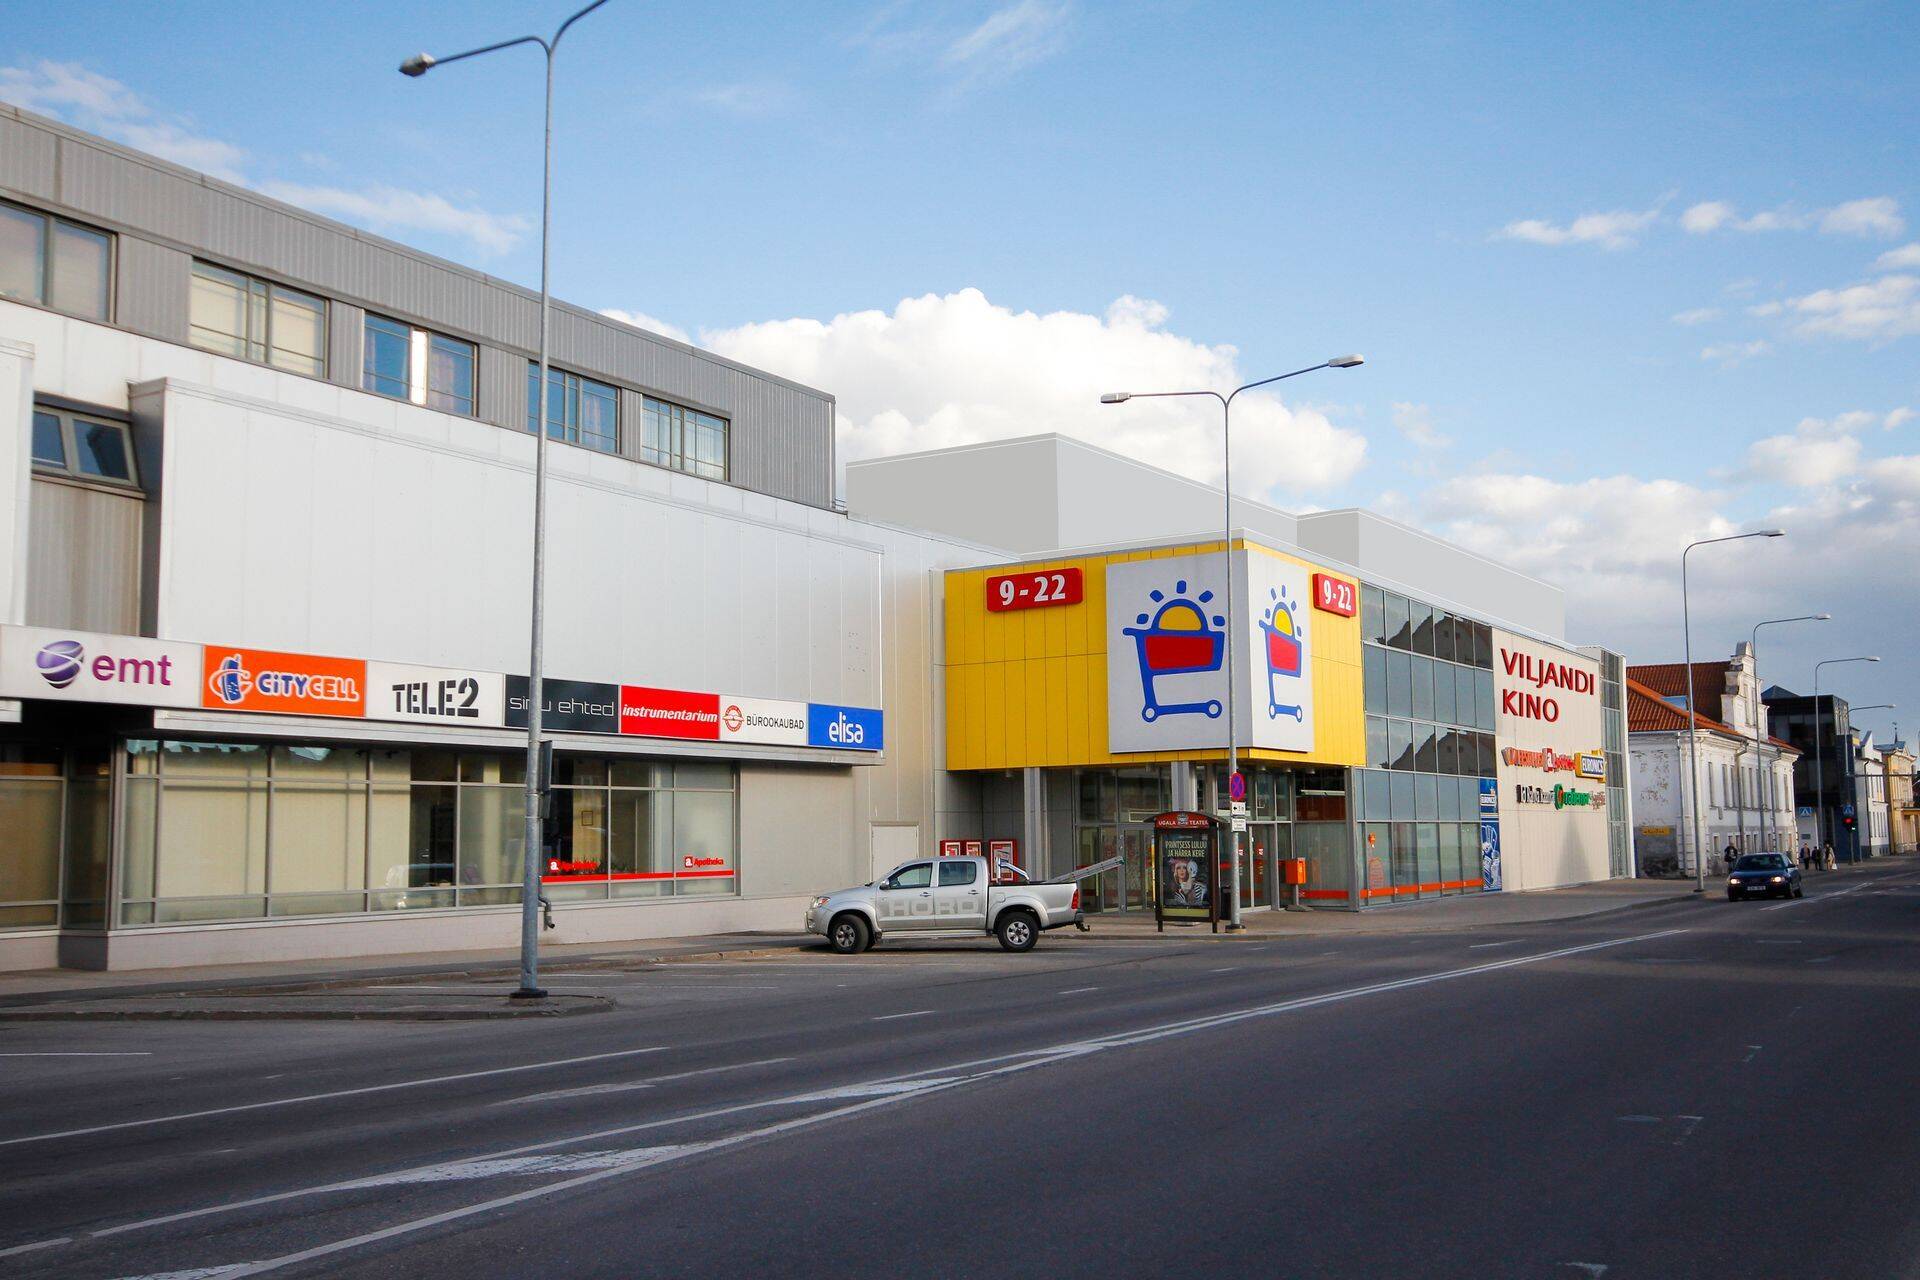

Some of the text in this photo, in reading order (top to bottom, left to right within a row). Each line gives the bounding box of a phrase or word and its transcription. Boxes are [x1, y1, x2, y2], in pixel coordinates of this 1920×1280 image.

[92, 655, 172, 686] emt
[1500, 648, 1594, 695] VILJANDI
[392, 677, 479, 718] TELE2
[558, 697, 614, 716] ehted
[622, 703, 718, 723] instrumentarium
[1502, 689, 1559, 722] KINO
[829, 711, 864, 744] elisa
